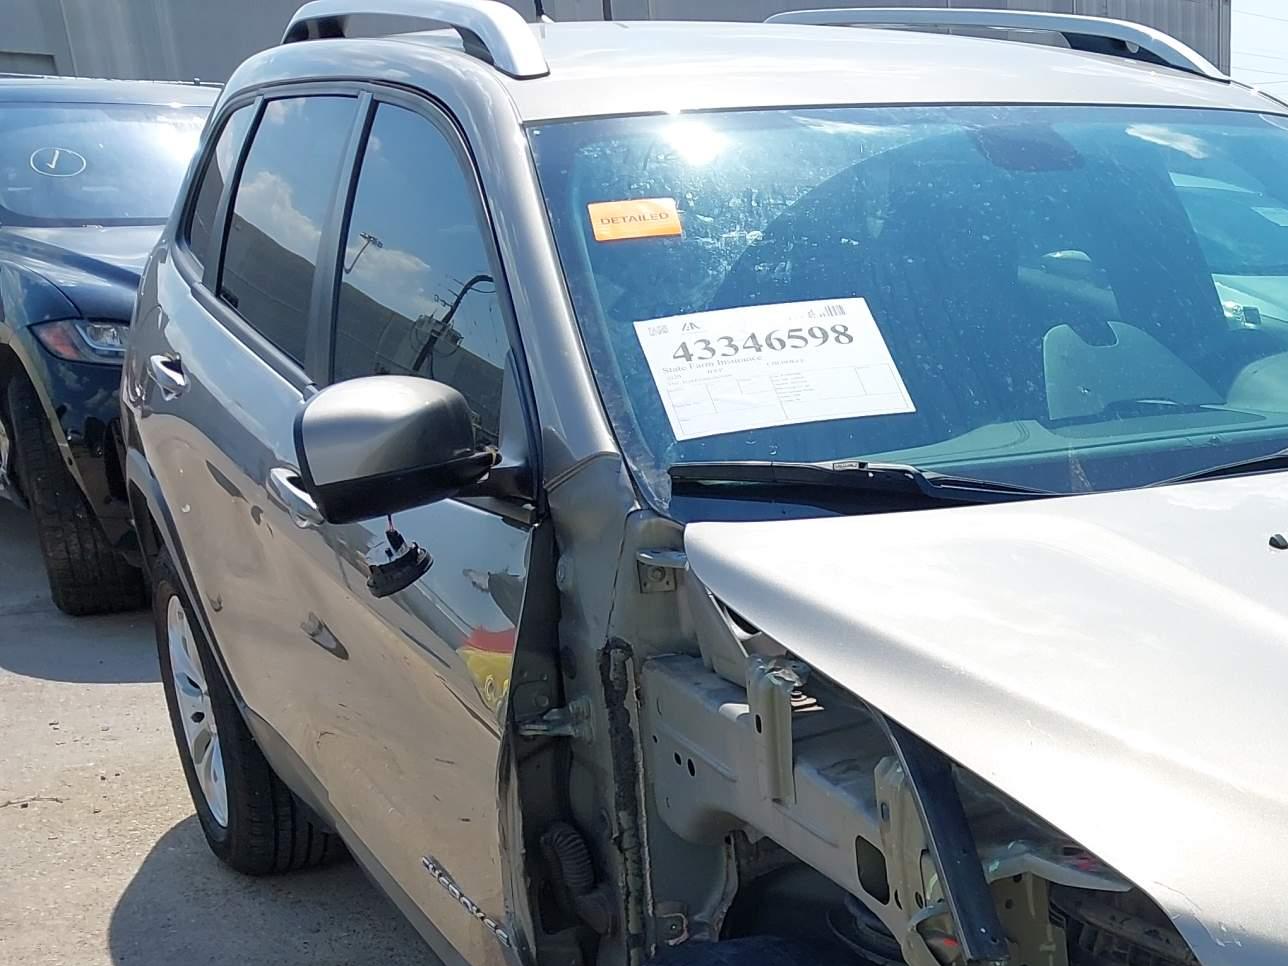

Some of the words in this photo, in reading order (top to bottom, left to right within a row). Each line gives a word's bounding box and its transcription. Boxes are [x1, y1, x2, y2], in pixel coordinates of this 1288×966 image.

[600, 212, 669, 225] DETAILED
[672, 323, 854, 363] 43346598
[661, 365, 687, 375] State
[688, 361, 716, 371] Farm
